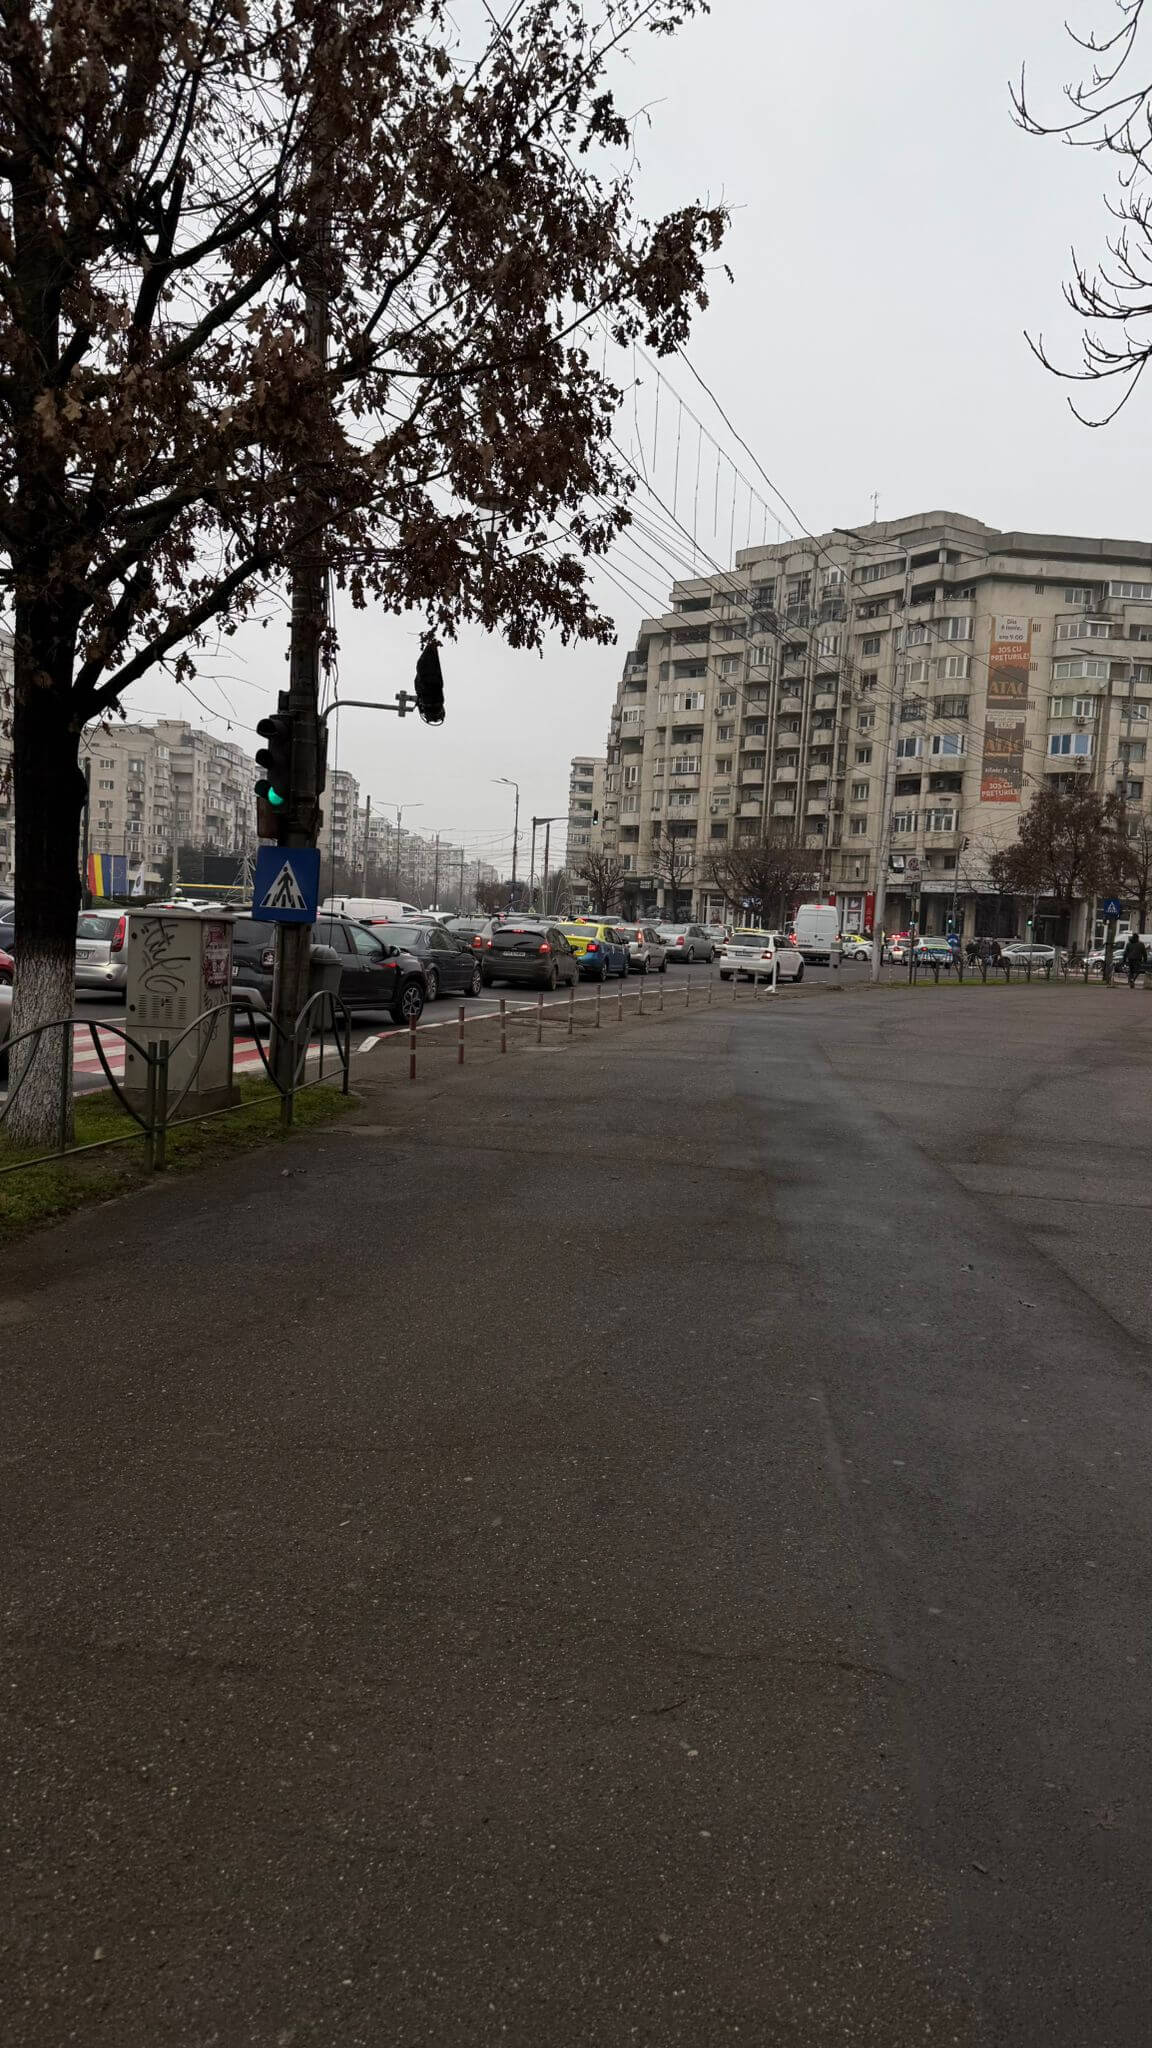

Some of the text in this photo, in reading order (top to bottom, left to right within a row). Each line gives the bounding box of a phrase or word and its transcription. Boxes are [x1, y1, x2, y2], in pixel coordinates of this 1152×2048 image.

[998, 645, 1022, 654] JOS CU
[990, 681, 1024, 694] ATAC
